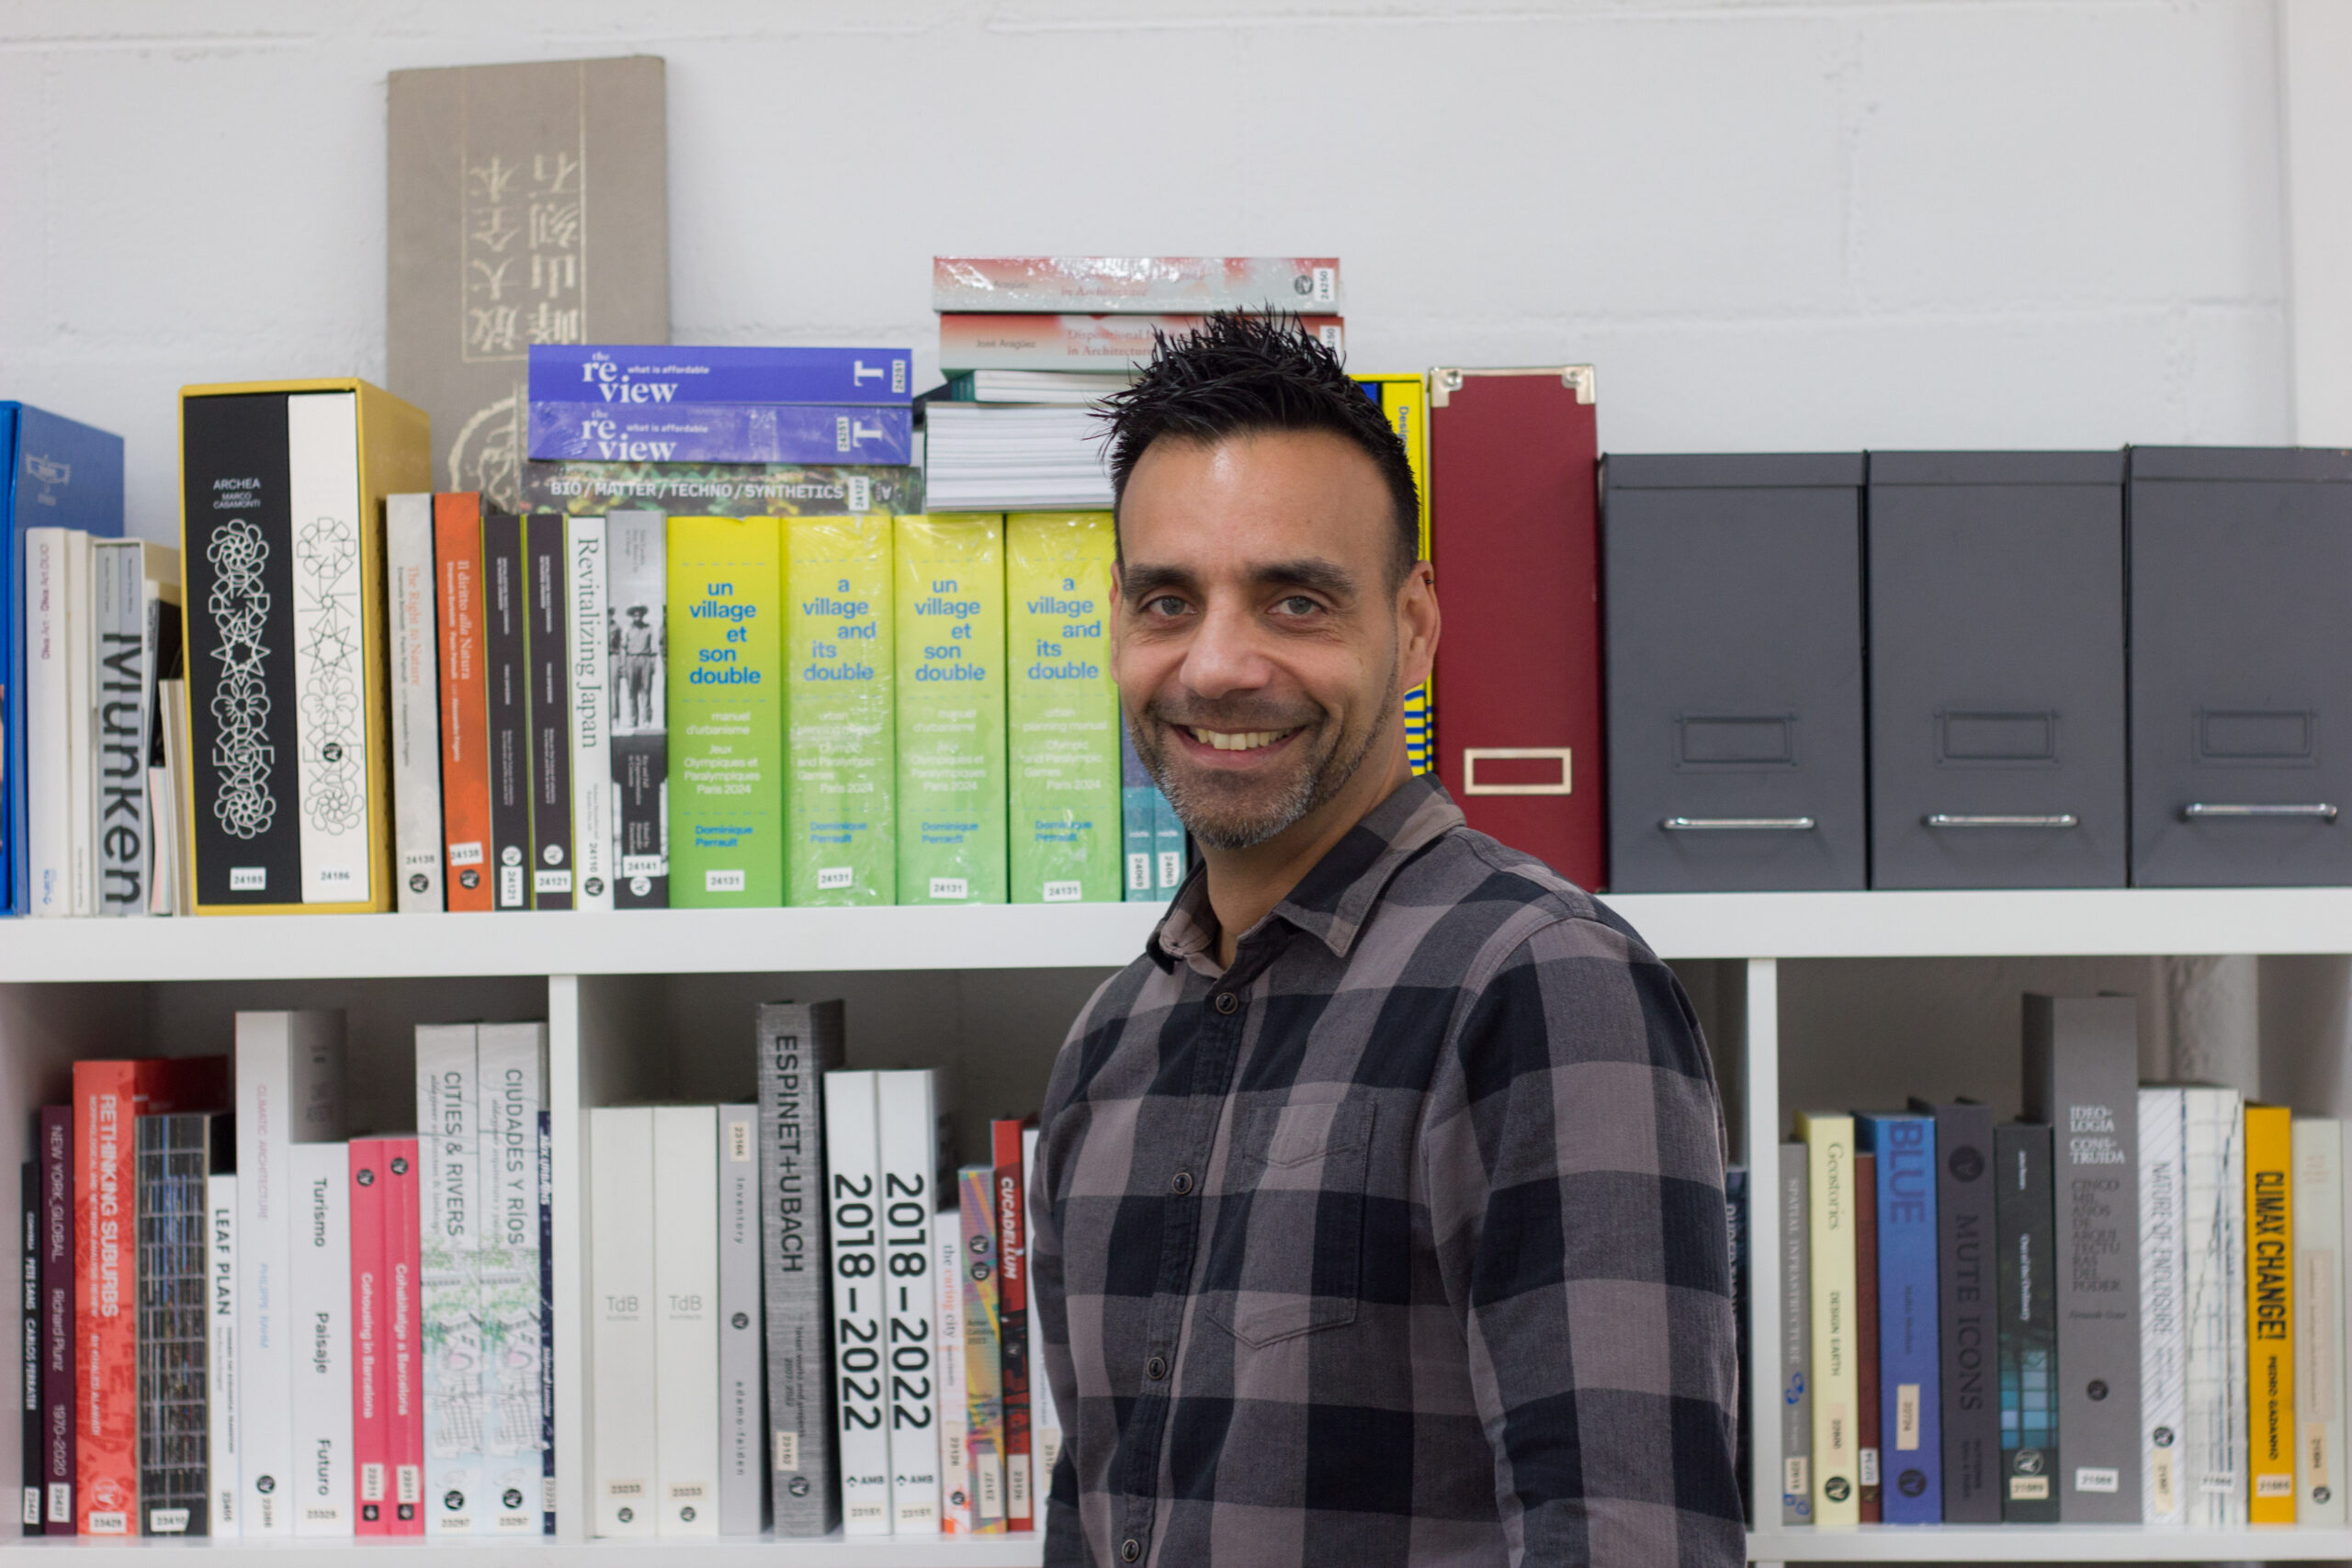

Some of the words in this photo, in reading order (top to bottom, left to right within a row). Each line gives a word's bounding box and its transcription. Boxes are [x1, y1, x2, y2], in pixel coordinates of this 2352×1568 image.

[1320, 270, 1329, 299] 24250
[976, 338, 996, 348] José
[999, 338, 1036, 350] Aragüez
[1068, 346, 1080, 356] in
[593, 351, 610, 362] the
[582, 360, 617, 382] re
[628, 365, 650, 375] what
[652, 365, 661, 375] is
[662, 364, 709, 375] affordable
[854, 360, 884, 387] T
[895, 361, 905, 392] 24251
[599, 375, 678, 403] view
[592, 410, 609, 421] the
[582, 418, 616, 440] re
[627, 423, 649, 434] what
[650, 423, 659, 434] is
[661, 423, 708, 434] affordable
[839, 418, 849, 451] 24251
[853, 421, 884, 447] T
[597, 434, 677, 461] view
[212, 477, 261, 491] ARCHEA
[744, 483, 844, 500] SYNTHETICS
[854, 478, 865, 508] 24127
[212, 499, 261, 509] CASAMONTI
[221, 492, 252, 501] MARCO
[406, 565, 420, 587] The
[838, 579, 850, 592] a
[933, 579, 957, 593] un
[1063, 578, 1075, 591] a
[458, 571, 470, 611] diritto
[707, 583, 733, 596] un
[406, 591, 421, 625] Right
[575, 537, 600, 676] Revitalizing
[689, 601, 756, 622] village
[802, 598, 869, 619] village
[914, 597, 981, 619] village
[1027, 596, 1094, 618] village
[410, 628, 420, 641] to
[459, 613, 471, 636] alla
[727, 626, 747, 642] et
[837, 622, 876, 639] and
[951, 623, 971, 639] et
[1062, 621, 1101, 638] and
[459, 637, 472, 681] Natura
[698, 649, 737, 662] son
[812, 641, 837, 659] its
[924, 646, 961, 660] son
[1036, 640, 1062, 657] its
[410, 644, 423, 686] Nature
[689, 666, 761, 684] double
[803, 663, 874, 681] double
[914, 663, 986, 682] double
[1028, 662, 1099, 680] double
[575, 681, 604, 749] Japan
[711, 711, 751, 721] manuel
[102, 632, 143, 904] Munken
[748, 758, 759, 768] et
[696, 784, 722, 795] Paris
[724, 784, 752, 795] 2024
[695, 825, 753, 837] Dominique
[695, 838, 738, 848] Perrault
[405, 854, 435, 864] 24138
[449, 849, 481, 860] 24138
[589, 842, 598, 874] 24110
[321, 871, 350, 880] 24186
[628, 861, 658, 872] 24141
[233, 874, 263, 884] 24185
[507, 868, 516, 902] 24121
[538, 876, 568, 887] 24121
[710, 876, 741, 886] 24131
[820, 874, 850, 884] 24131
[933, 884, 963, 894] 24131
[1048, 886, 1079, 896] 24131
[444, 1071, 462, 1135] CITIES
[504, 1068, 525, 1167] CIUDADES
[51, 1124, 63, 1155] NEW
[445, 1139, 459, 1154] &
[2069, 1137, 2117, 1151] CONS-
[99, 1094, 118, 1216] RETHINKING
[776, 1035, 804, 1273] ESPINET+UBACH
[2070, 1151, 2126, 1164] TRUIDA
[506, 1171, 521, 1186] Y
[1888, 1122, 1926, 1224] BLUE
[1827, 1142, 1845, 1231] Geostories
[2152, 1161, 2172, 1218] NATURE
[446, 1163, 465, 1236] RIVERS
[1788, 1179, 1800, 1234] SPATIAL
[2255, 1170, 2285, 1235] CLIMAX
[313, 1179, 328, 1248] Turismo
[506, 1190, 526, 1246] RÍOS
[215, 1208, 230, 1255] LEAF
[1001, 1176, 1016, 1280] CUCADELLUM
[2152, 1224, 2172, 1240] OF
[943, 1245, 956, 1266] the
[1955, 1214, 1981, 1304] MUTE
[100, 1221, 119, 1317] SUBURBS
[216, 1262, 232, 1316] PLAN
[943, 1269, 956, 1311] caring
[2152, 1249, 2174, 1335] ENCLOSURE
[2256, 1240, 2287, 1341] CHANGE!
[359, 1272, 374, 1339] Cohousing
[393, 1263, 409, 1340] Cohabitatge
[606, 1296, 639, 1313] TdB
[668, 1295, 702, 1312] TdB
[834, 1174, 882, 1431] 2018-2022
[887, 1172, 928, 1431] 2018-2022
[1788, 1240, 1802, 1364] INFRASTRUCTURE
[1829, 1291, 1841, 1333] DESIGN
[52, 1289, 65, 1337] Richard
[944, 1314, 958, 1337] city
[52, 1339, 64, 1371] Plunz
[312, 1313, 330, 1375] Paisaje
[363, 1342, 374, 1353] in
[1830, 1338, 1842, 1377] EARTH
[1956, 1314, 1984, 1413] ICONS
[363, 1355, 376, 1418] Barcelona
[396, 1353, 410, 1416] Barcelona
[53, 1404, 67, 1476] 1970-2020
[736, 1381, 745, 1477] adamo-faiden
[2267, 1399, 2278, 1461] GADANHO
[317, 1439, 332, 1496] Futuro
[861, 1476, 885, 1484] AMB
[910, 1475, 934, 1484] AMB
